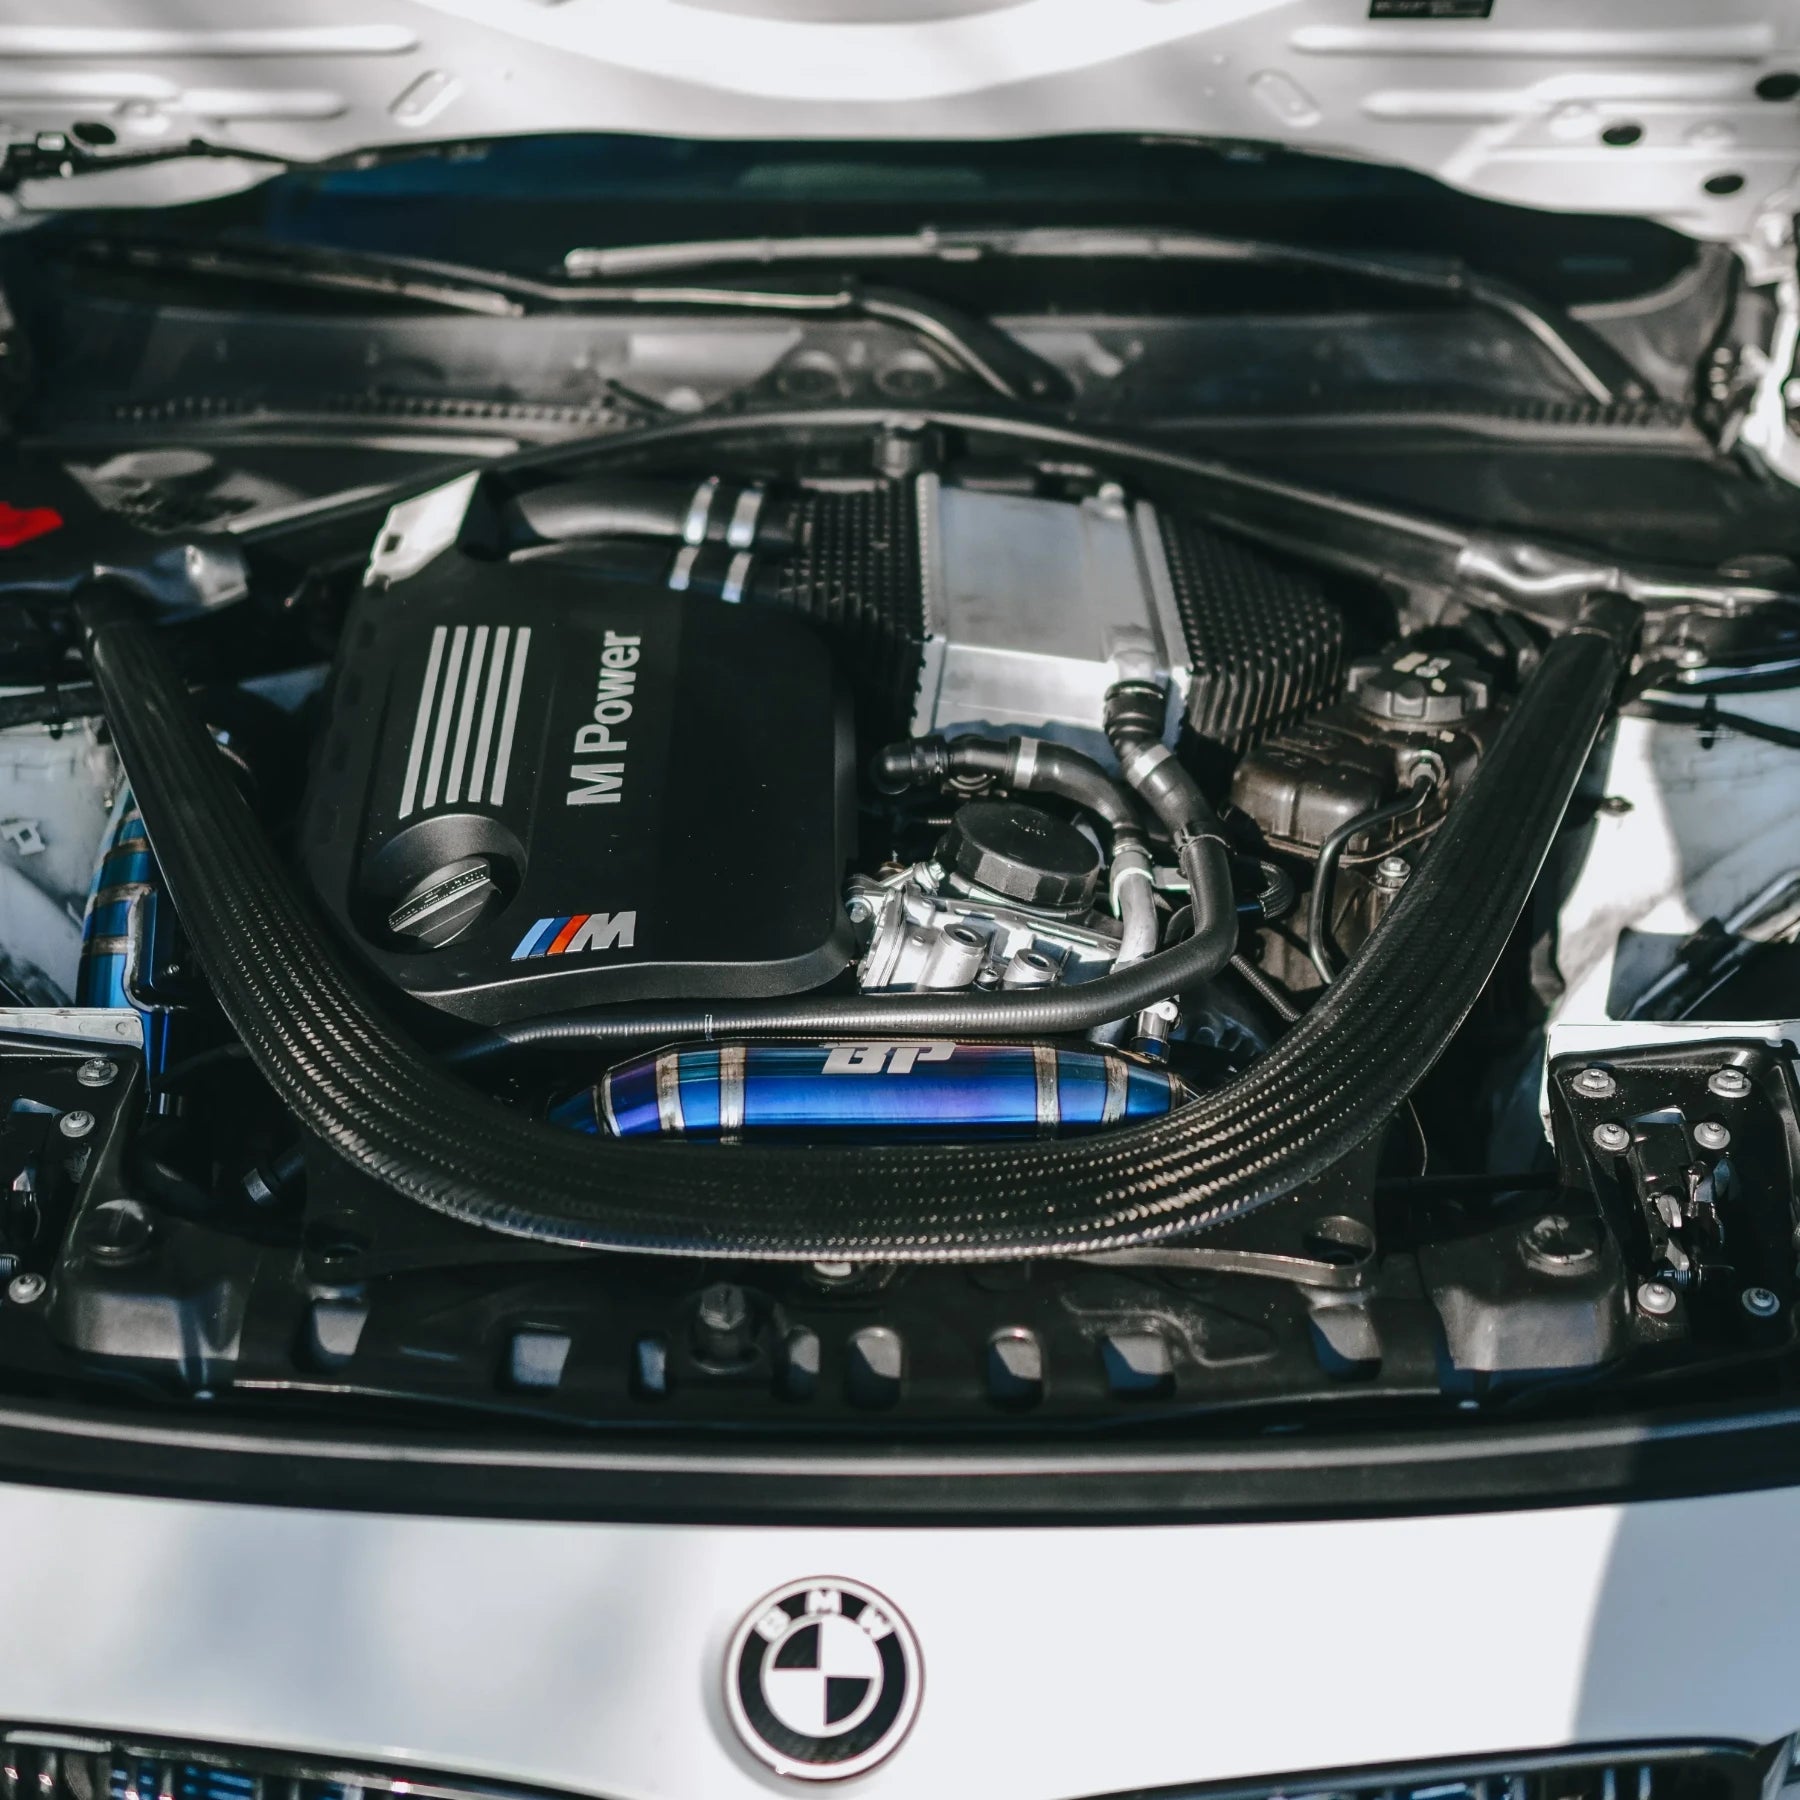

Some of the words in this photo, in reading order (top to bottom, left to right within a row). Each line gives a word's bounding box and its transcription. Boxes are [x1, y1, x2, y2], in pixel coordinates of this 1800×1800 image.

[573, 629, 642, 754] Power
[566, 762, 625, 806] M
[564, 910, 637, 954] M
[754, 1587, 896, 1642] BMW
